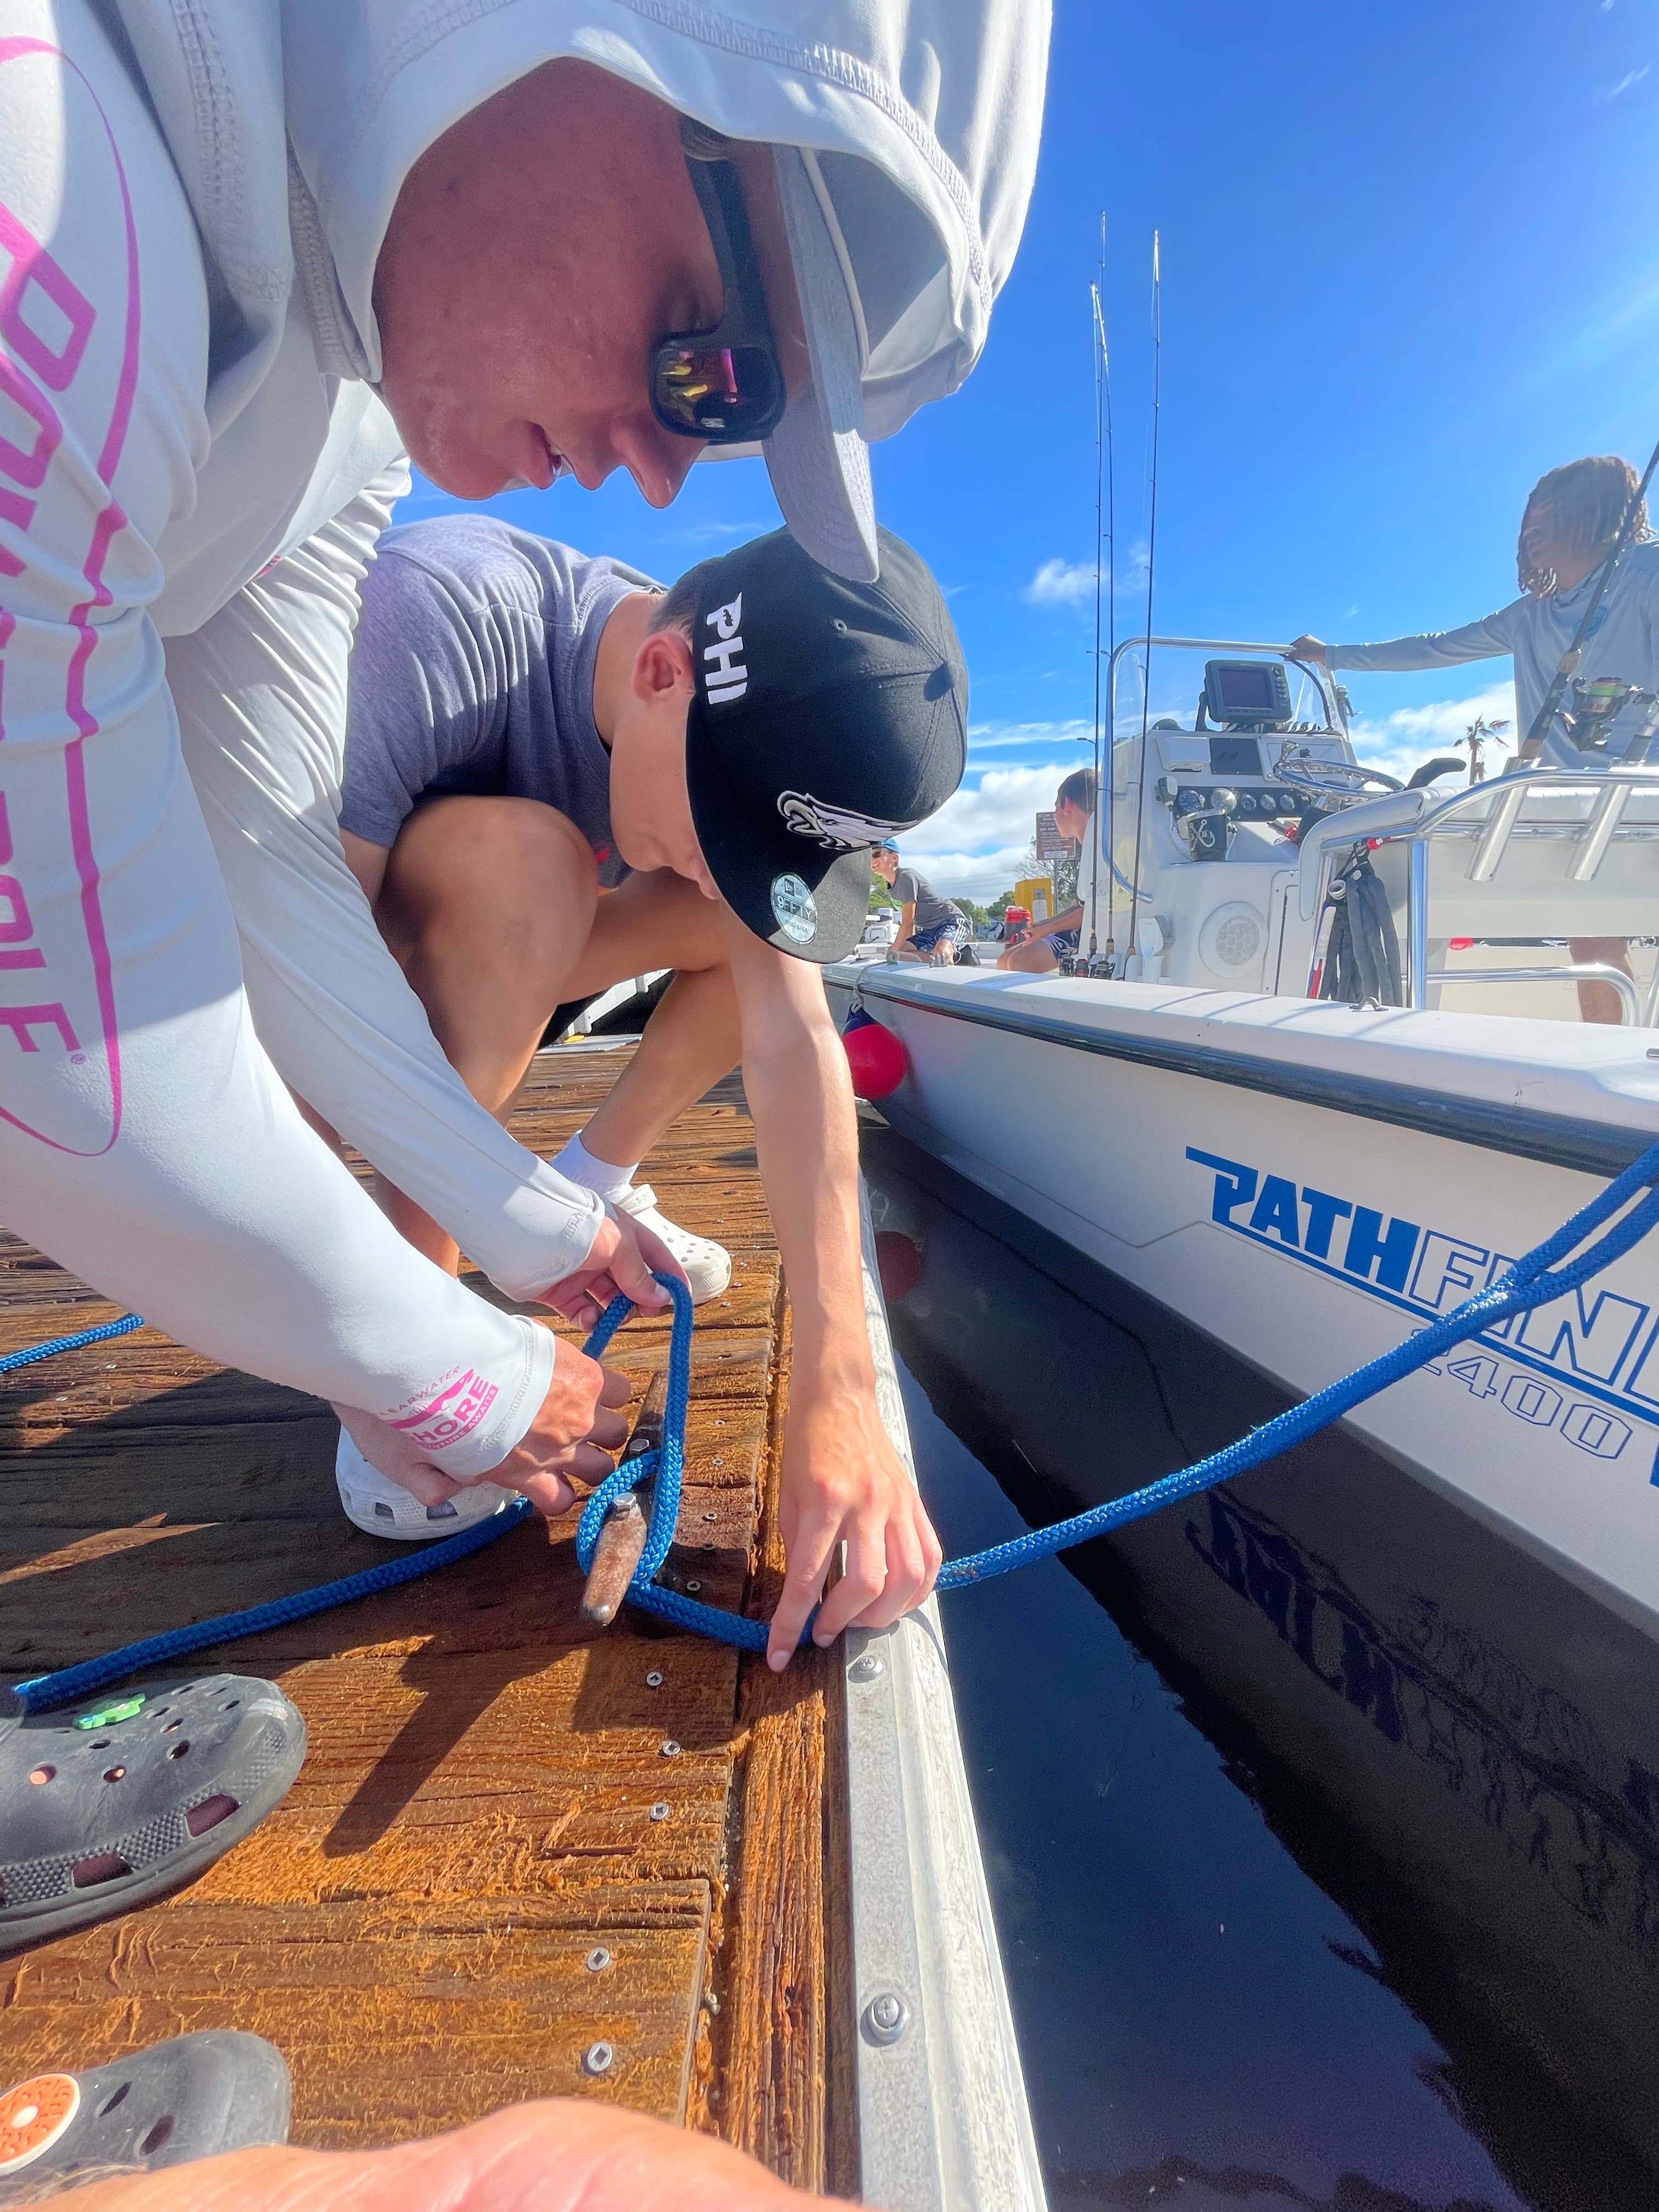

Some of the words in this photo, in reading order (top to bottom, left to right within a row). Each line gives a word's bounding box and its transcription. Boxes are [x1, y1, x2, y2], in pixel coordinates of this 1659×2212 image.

[704, 591, 748, 705] PHI
[379, 1365, 460, 1416] LEARWATER
[411, 1375, 489, 1442] HORE
[468, 1388, 496, 1430] AWAITS
[1412, 1329, 1633, 1459] 400
